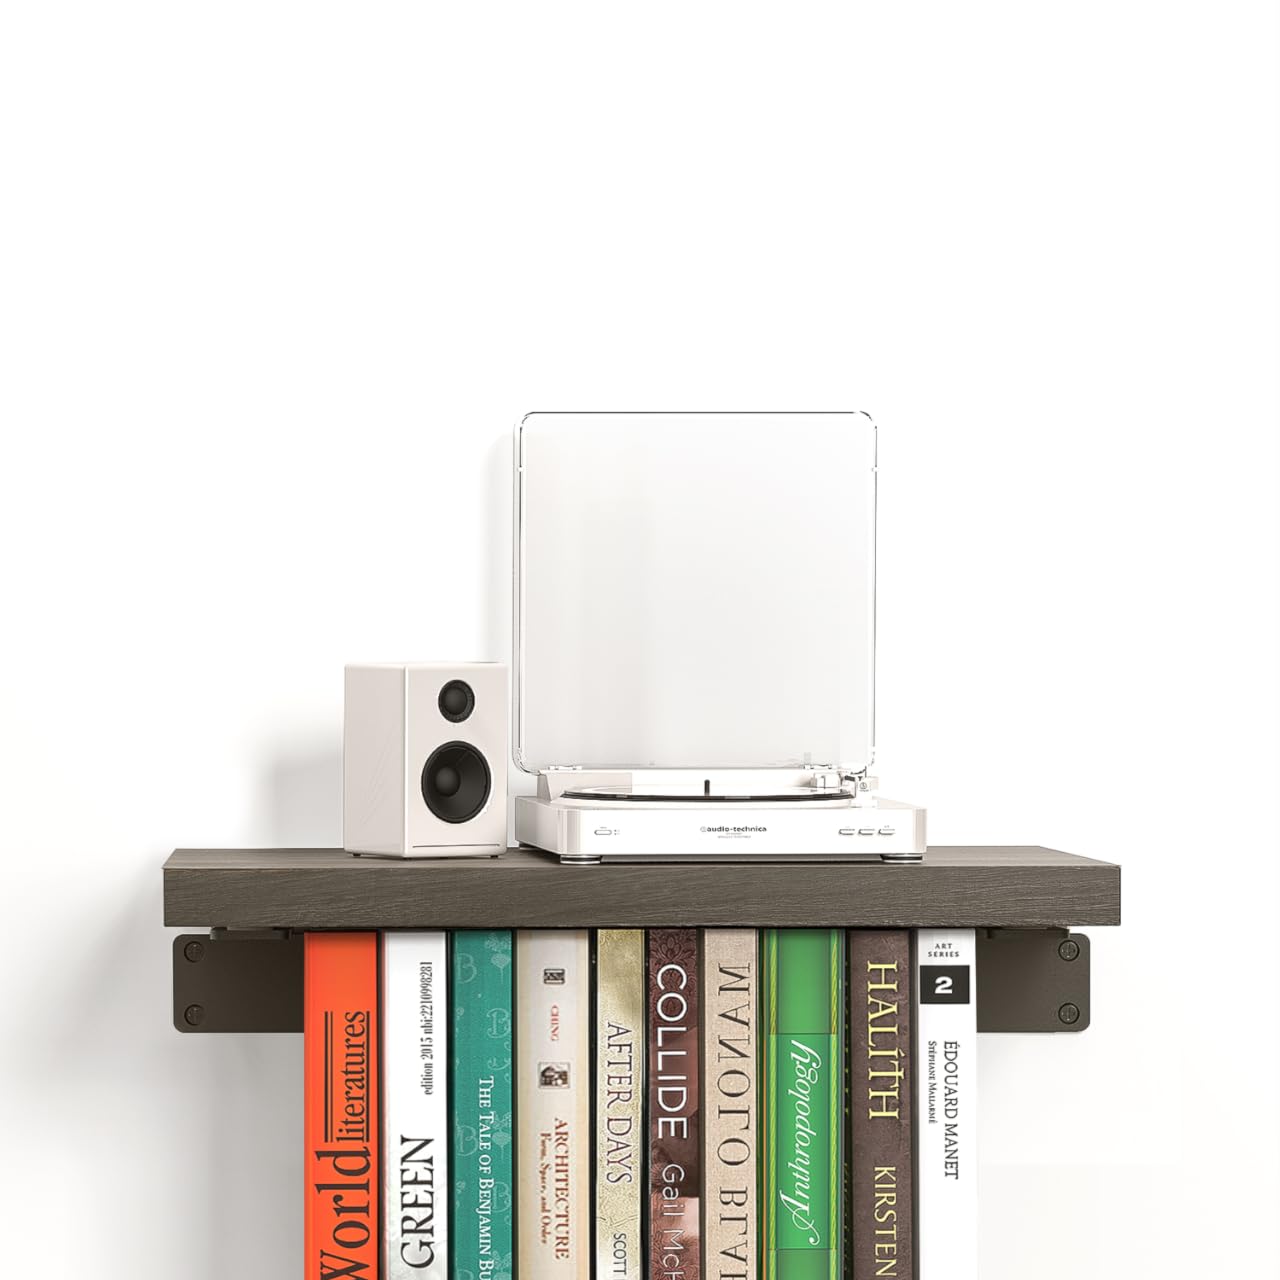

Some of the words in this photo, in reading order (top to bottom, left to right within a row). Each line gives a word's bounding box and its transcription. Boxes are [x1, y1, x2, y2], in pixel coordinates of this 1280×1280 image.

[934, 942, 953, 950] ART
[935, 976, 953, 995] 2
[422, 1037, 433, 1059] 2015
[551, 1005, 559, 1041] CHING
[657, 964, 688, 1139] COLLIDE
[336, 1011, 365, 1142] literatures
[422, 1063, 433, 1095] edition
[478, 1076, 494, 1109] THE
[606, 1022, 633, 1109] AFTER
[943, 1040, 961, 1119] ÉDOUARD
[478, 1113, 494, 1151] TALE
[606, 1117, 633, 1183] DAYS
[779, 1040, 822, 1245] Anthropology
[944, 1123, 959, 1180] MANET
[478, 1155, 492, 1174] OF
[554, 1118, 570, 1260] ARCHITECTURE
[661, 1164, 685, 1217] Gail
[401, 1134, 435, 1268] GREEN
[477, 1177, 494, 1256] BENJAMIN
[874, 1166, 897, 1277] KIRSTEN
[613, 1232, 627, 1274] SCOTT
